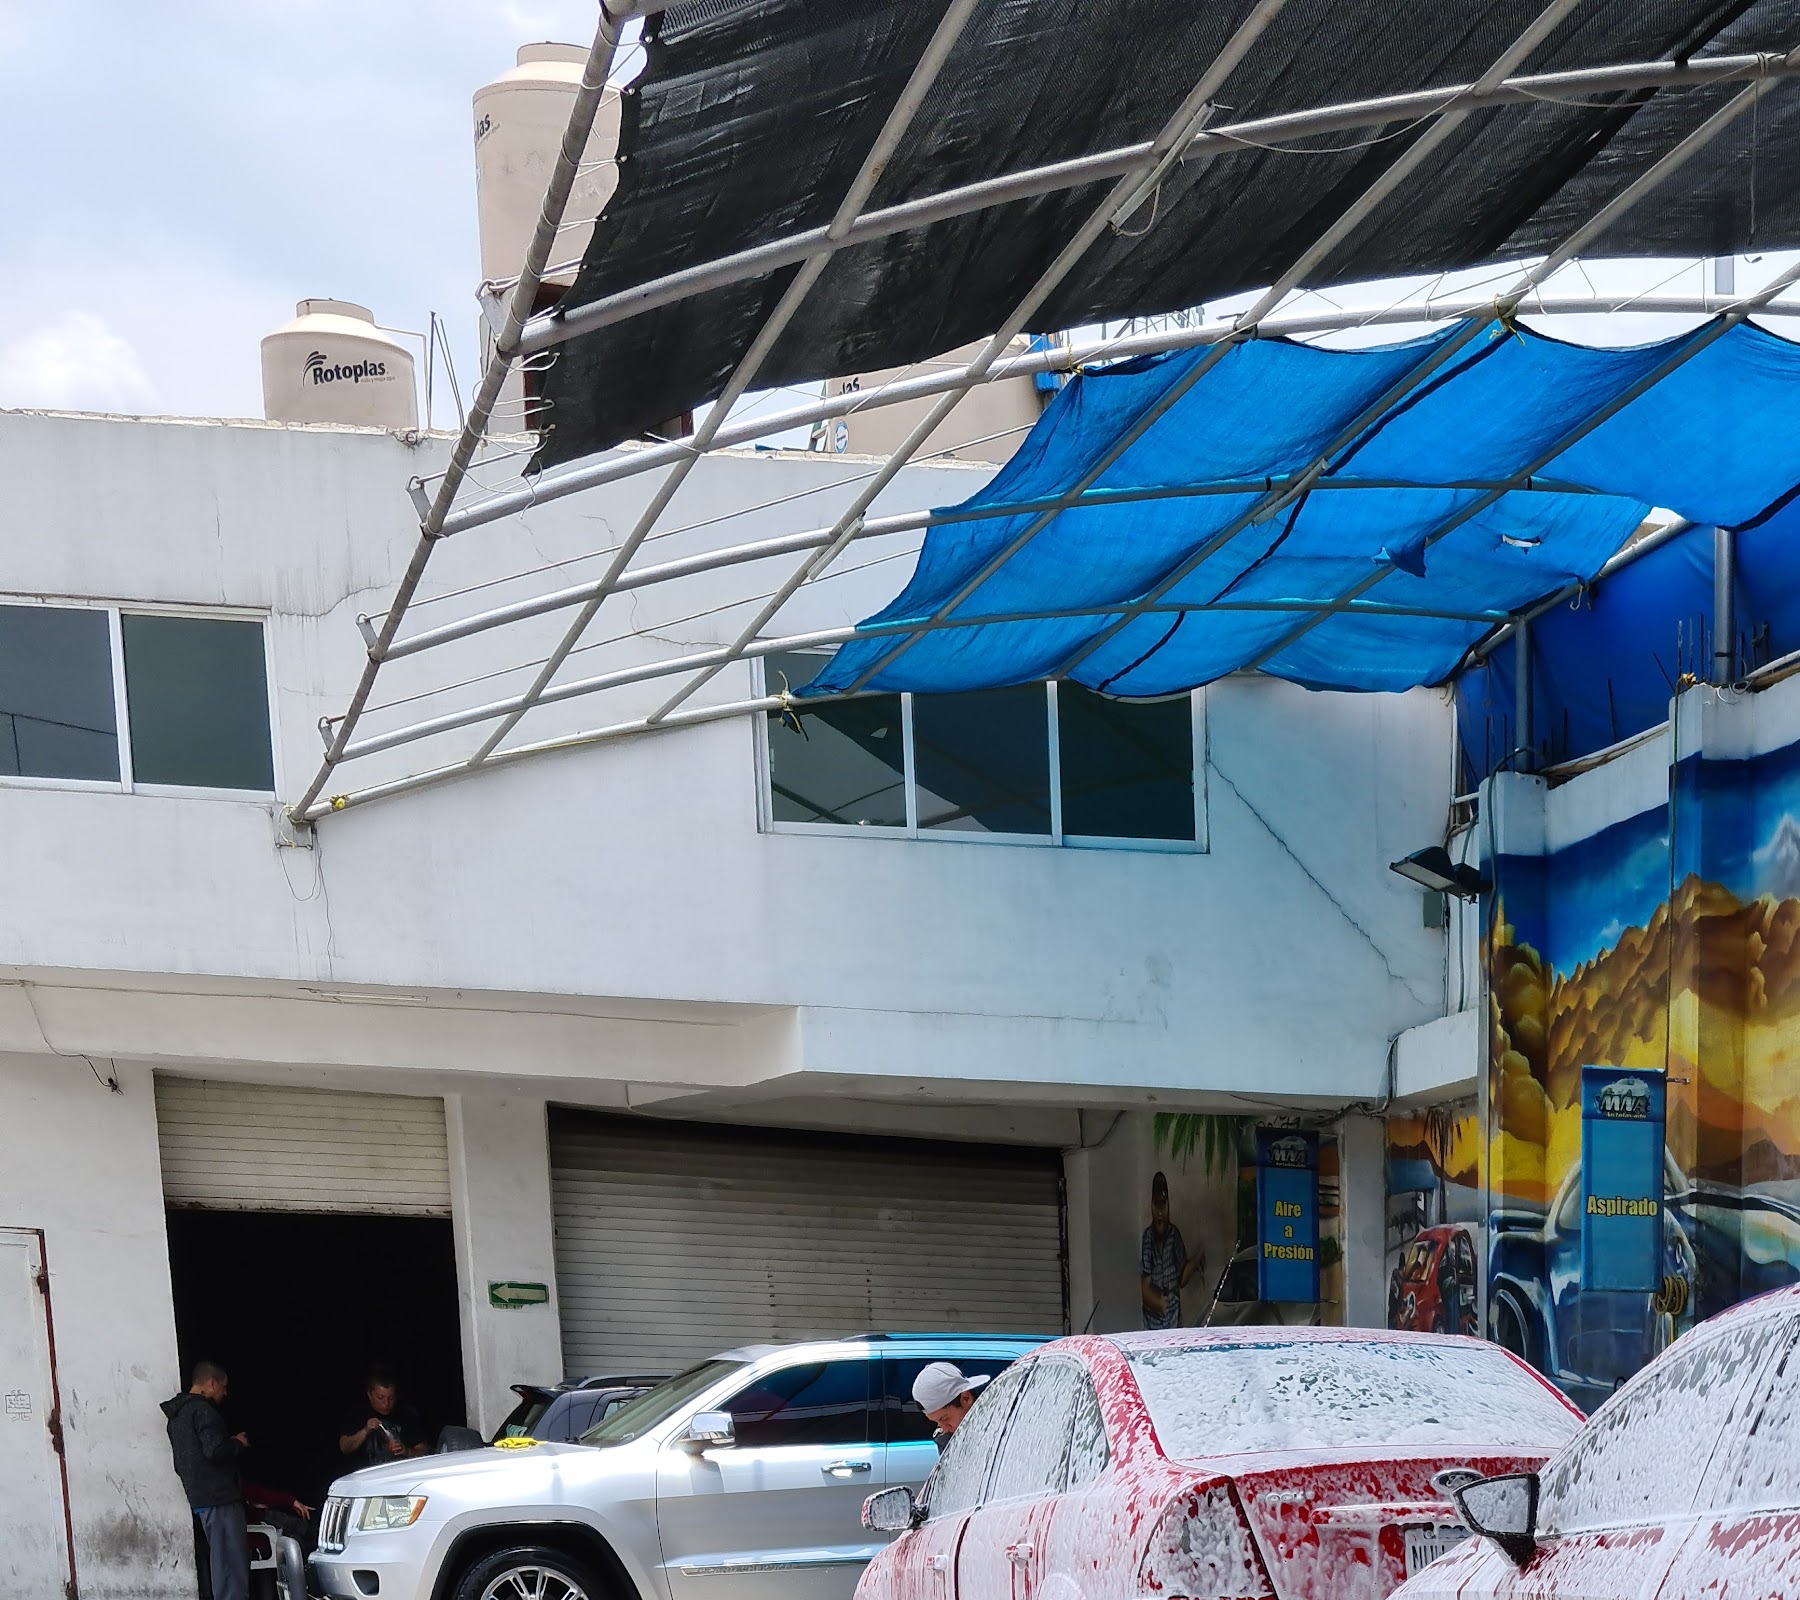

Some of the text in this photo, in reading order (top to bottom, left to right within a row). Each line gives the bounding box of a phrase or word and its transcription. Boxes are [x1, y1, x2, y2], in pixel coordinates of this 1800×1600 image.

[313, 360, 386, 385] Rotoplas
[1600, 1094, 1648, 1113] MNA
[1275, 1200, 1302, 1217] Aire
[1586, 1195, 1658, 1216] Aspirado
[1284, 1225, 1293, 1238] a
[1263, 1242, 1314, 1260] Presión
